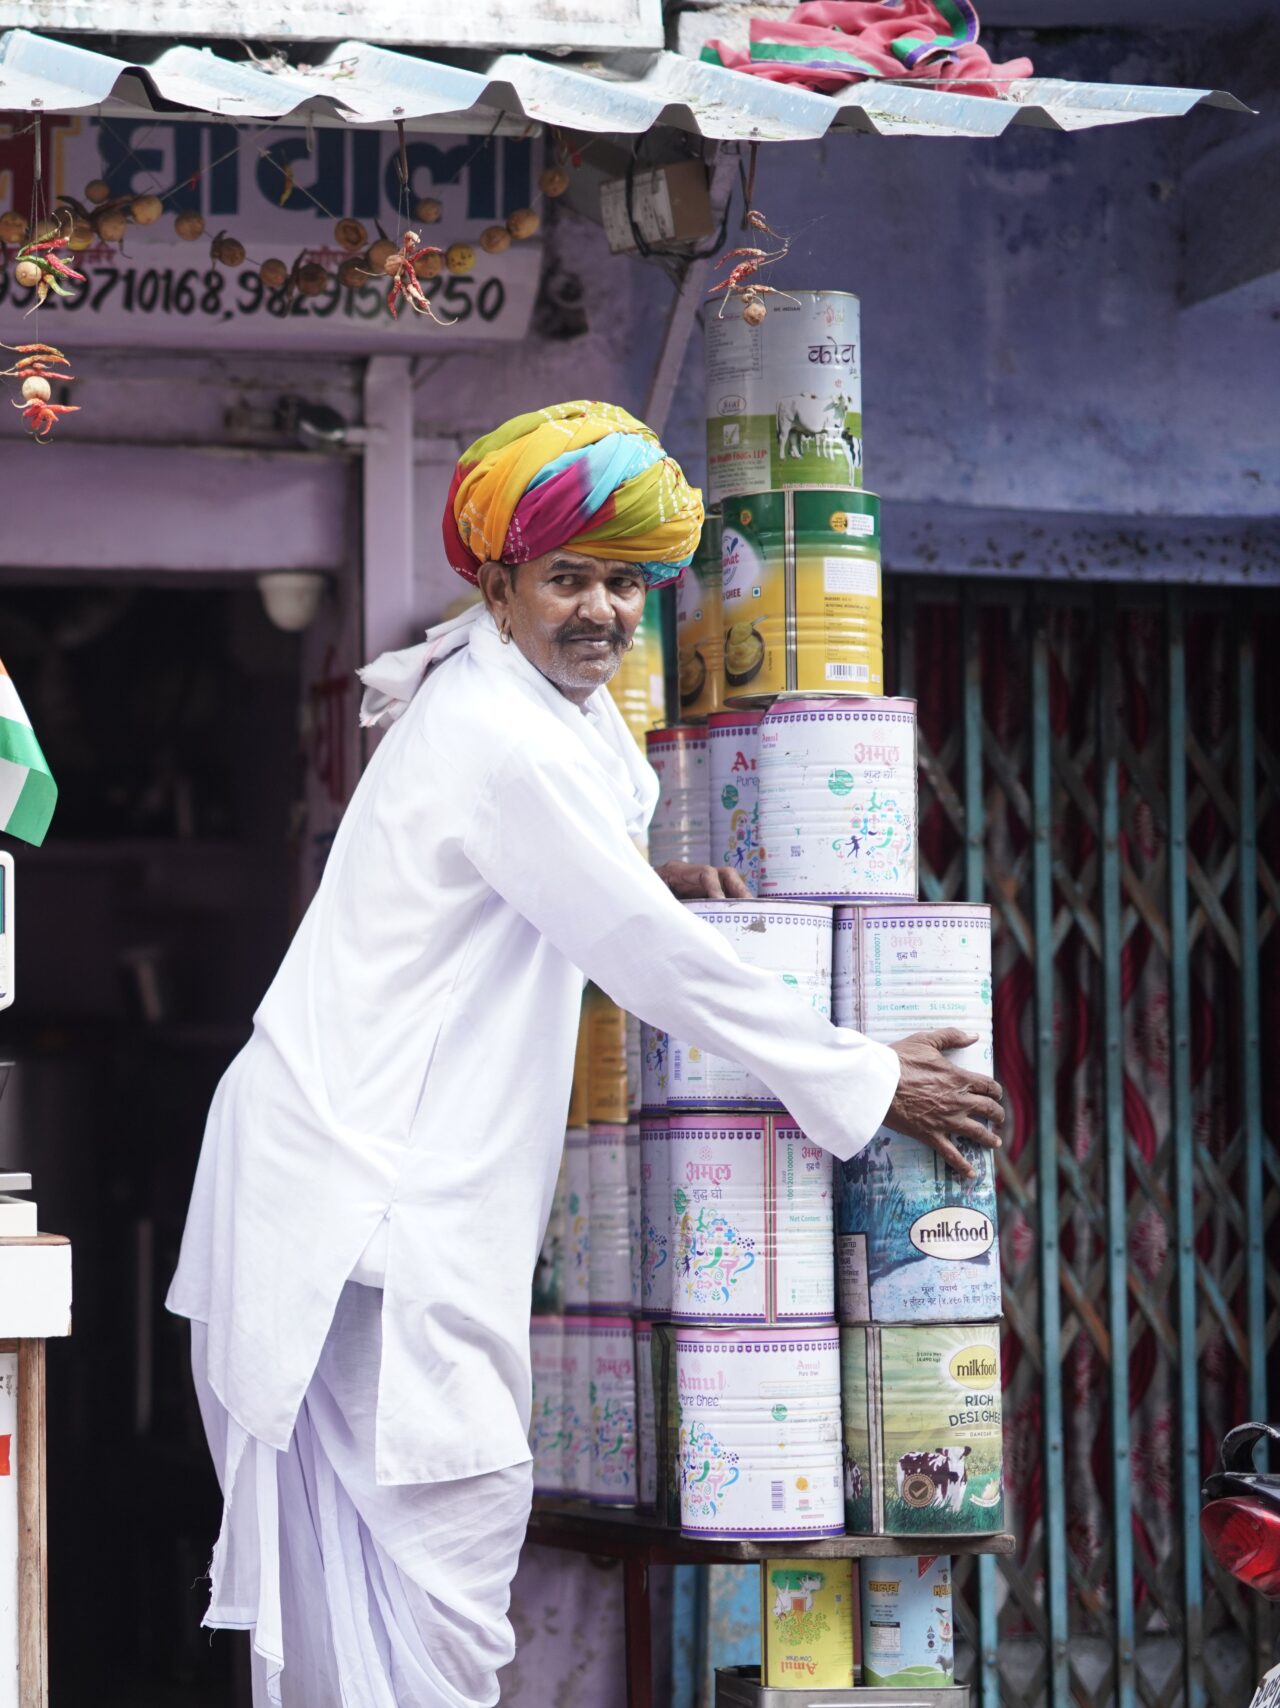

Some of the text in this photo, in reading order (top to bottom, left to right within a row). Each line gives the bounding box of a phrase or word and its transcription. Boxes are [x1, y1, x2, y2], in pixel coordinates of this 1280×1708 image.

[686, 1161, 732, 1185] अमूल
[919, 1221, 989, 1244] milkfood
[957, 1359, 997, 1377] milkfood
[679, 1369, 726, 1391] Amul
[965, 1394, 994, 1408] RICH
[949, 1410, 979, 1427] DESI
[781, 1661, 818, 1676] Amul
